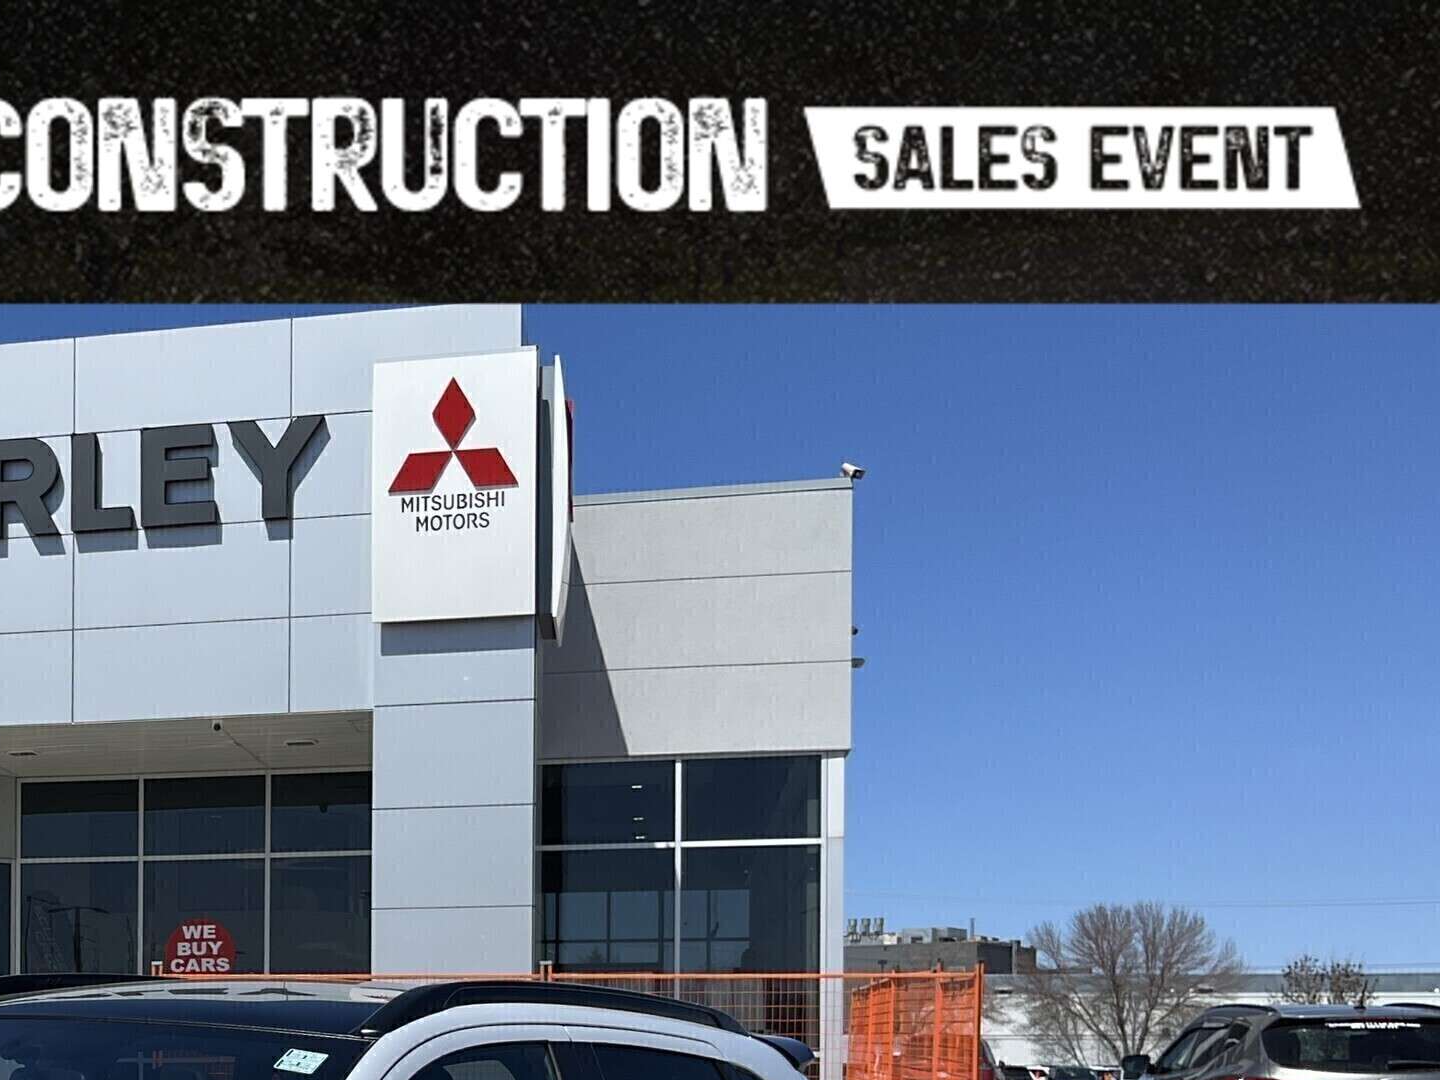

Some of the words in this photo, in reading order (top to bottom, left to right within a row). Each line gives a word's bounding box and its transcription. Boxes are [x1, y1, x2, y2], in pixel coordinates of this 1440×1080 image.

[401, 491, 505, 513] MITSUBISHI
[416, 512, 490, 532] MOTORS
[182, 925, 216, 939] WE
[177, 941, 222, 956] BUY
[170, 957, 230, 972] CARS
